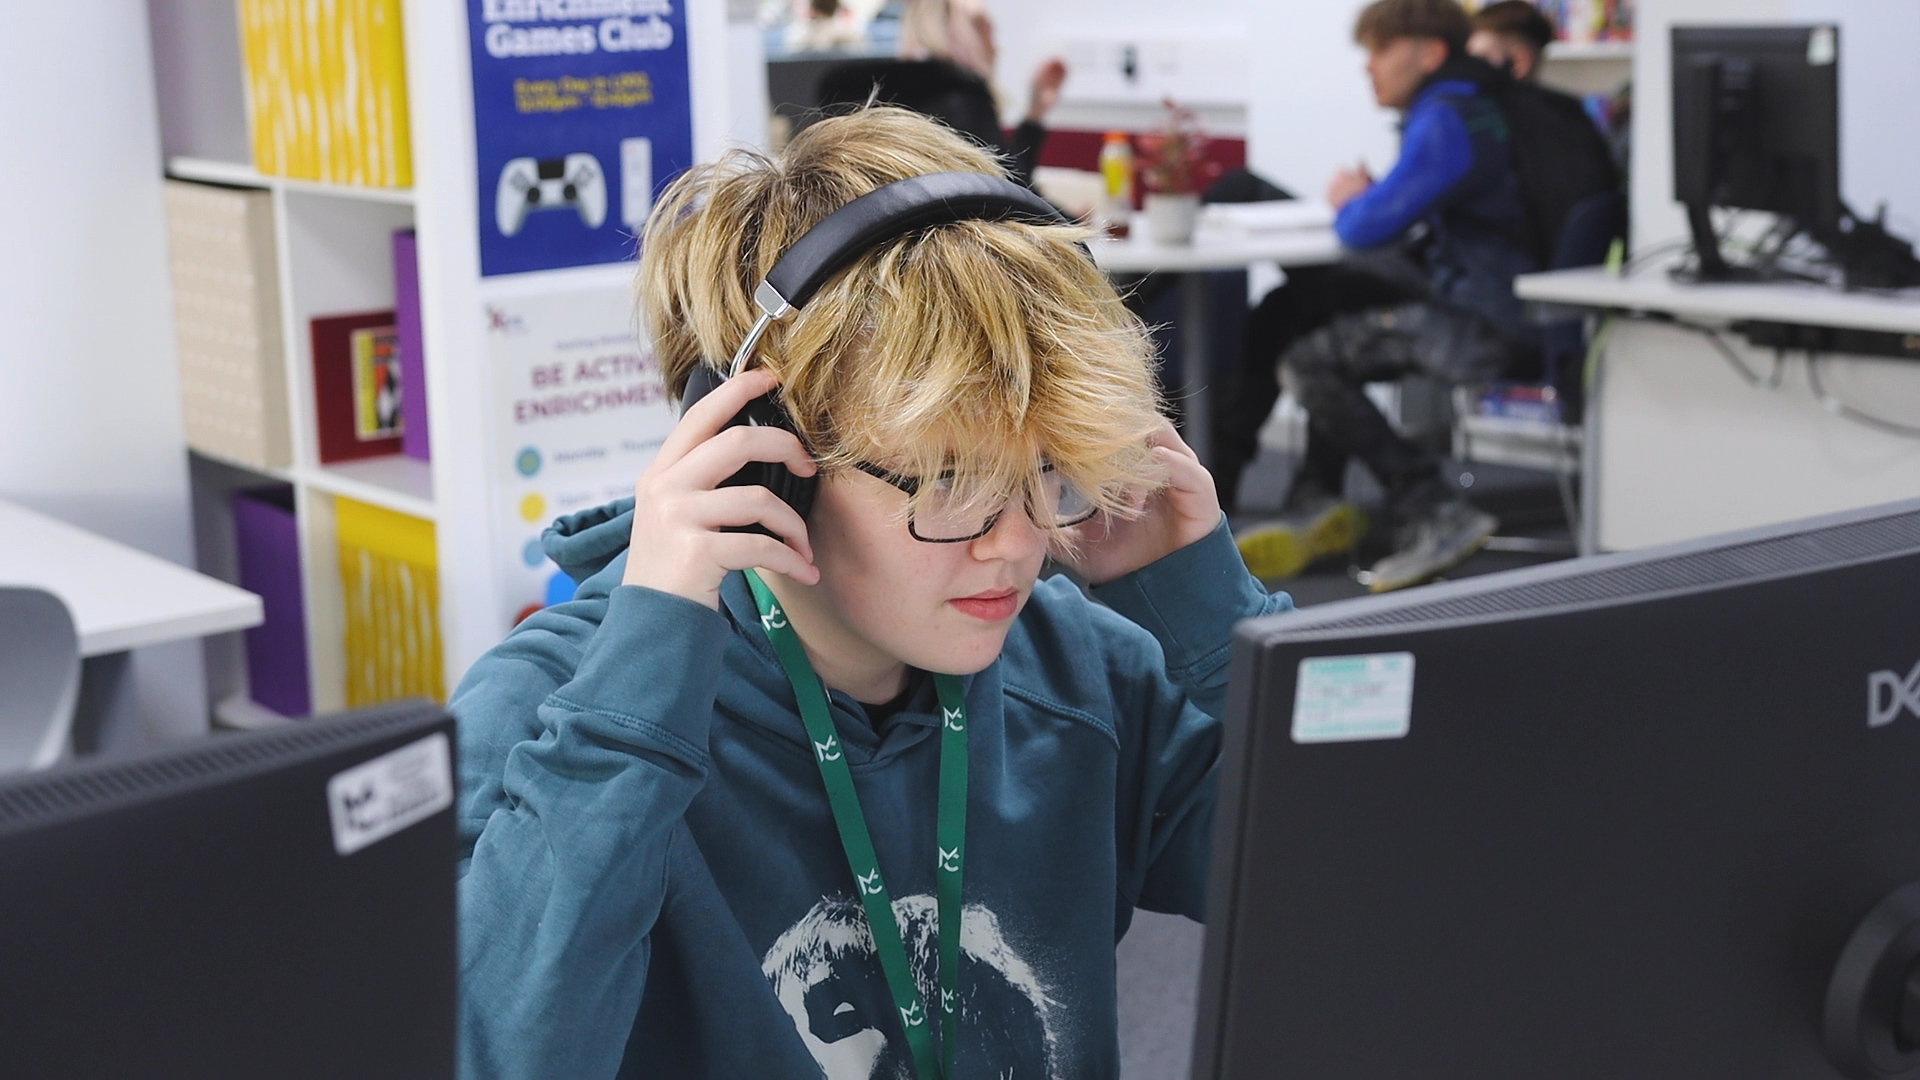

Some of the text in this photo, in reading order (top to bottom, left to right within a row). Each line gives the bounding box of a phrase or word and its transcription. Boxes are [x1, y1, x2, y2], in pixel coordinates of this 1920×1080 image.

[482, 0, 673, 22] Enrichment
[485, 16, 674, 57] Games Club
[532, 364, 563, 389] BE
[514, 384, 667, 423] ENRICHMEN
